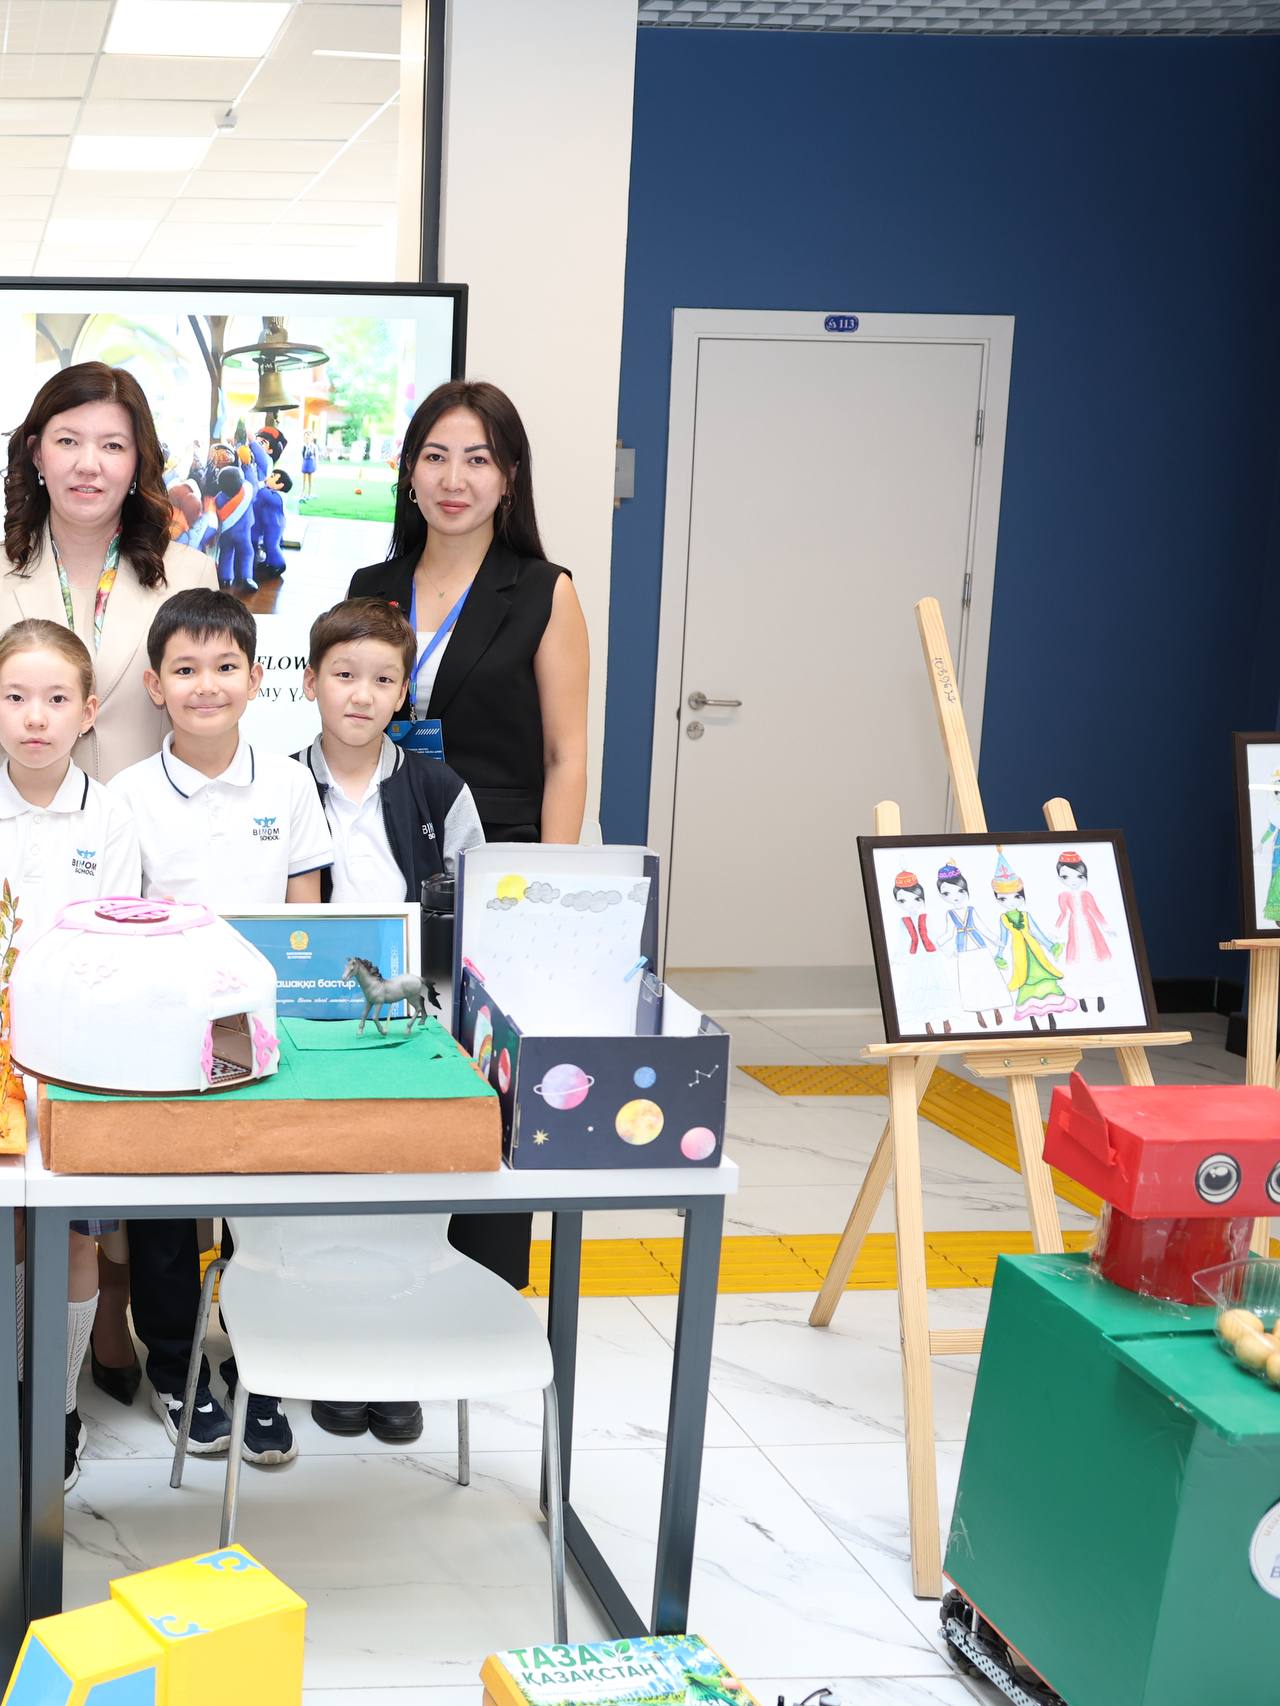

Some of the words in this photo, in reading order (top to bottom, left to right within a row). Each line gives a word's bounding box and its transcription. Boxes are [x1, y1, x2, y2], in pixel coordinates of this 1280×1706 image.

[840, 319, 855, 329] 113
[252, 828, 280, 836] BINOM
[72, 858, 97, 870] BINOM
[276, 979, 316, 989] ашаққа
[508, 1645, 603, 1669] ТАЗА
[521, 1663, 659, 1687] ҚАЗАҚСТАН
